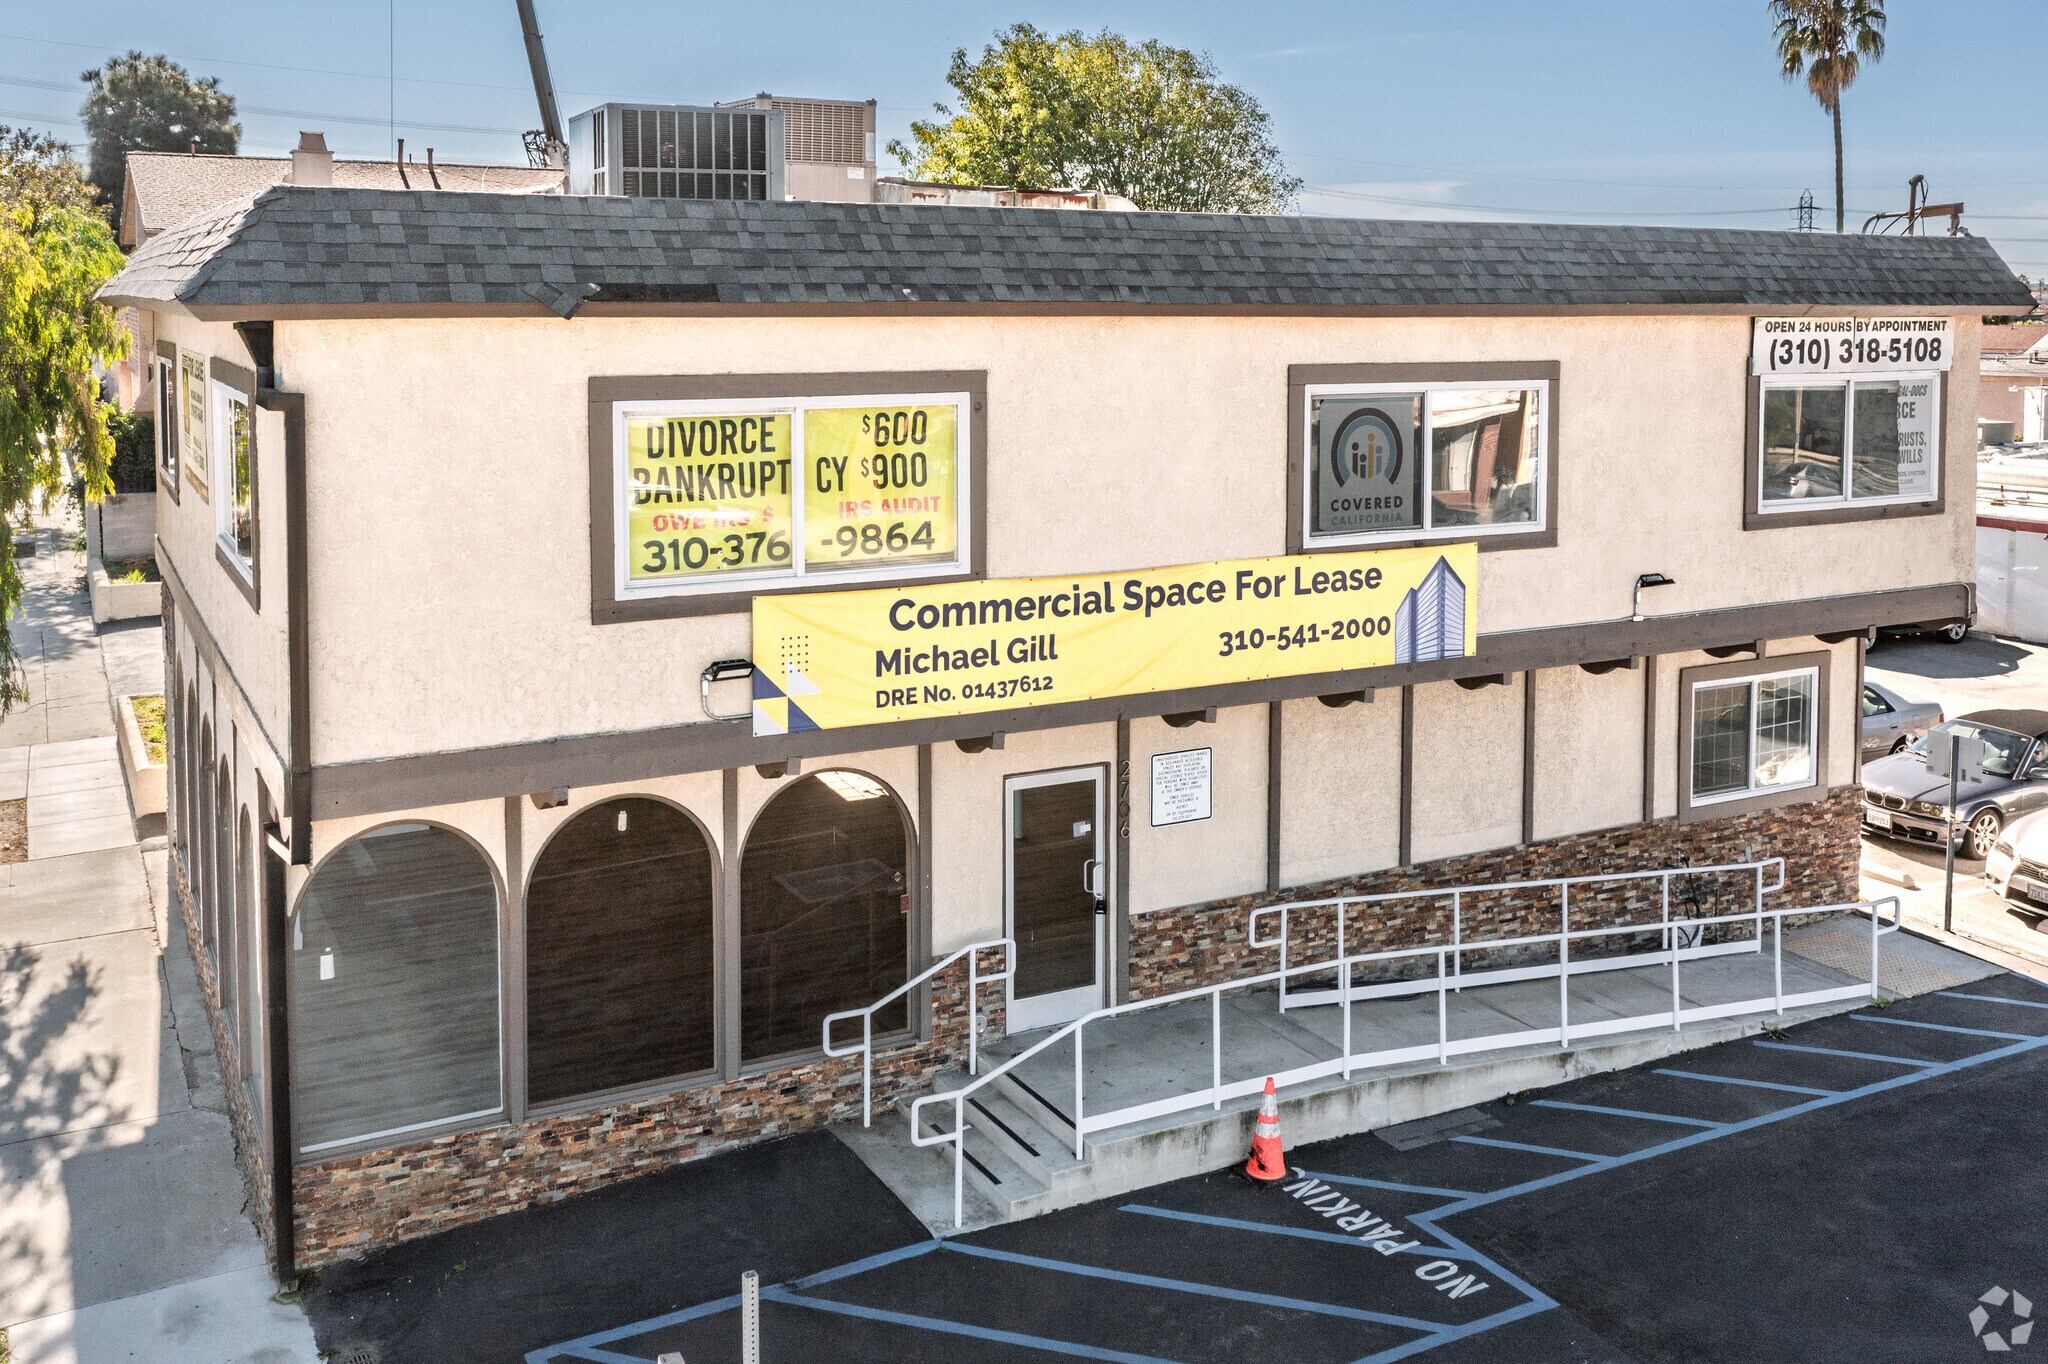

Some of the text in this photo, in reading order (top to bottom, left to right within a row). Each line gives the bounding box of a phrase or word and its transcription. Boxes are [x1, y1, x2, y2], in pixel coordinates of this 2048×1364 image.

[1765, 320, 1947, 333] OPEN 24 HOURS BY APPOINTMENT
[1770, 337, 1942, 370] (310) 318-5108
[646, 411, 928, 459] DIVORCE $600
[632, 451, 928, 505] BANKRUPT CY $900
[652, 513, 706, 532] OWE
[838, 499, 873, 520] IRS
[881, 495, 942, 516] AUDIT
[1331, 496, 1404, 513] COVERED
[1331, 512, 1404, 527] CALIFORNIA
[642, 520, 936, 573] 310-376 -9864
[889, 566, 1383, 632] Commercial Space For Lease
[875, 633, 1059, 678] Michael Gill
[1219, 615, 1392, 657] 310-541-2000
[875, 675, 1054, 709] DRE No. 01437612
[1119, 760, 1131, 839] 2706
[1415, 1260, 1489, 1300] NO
